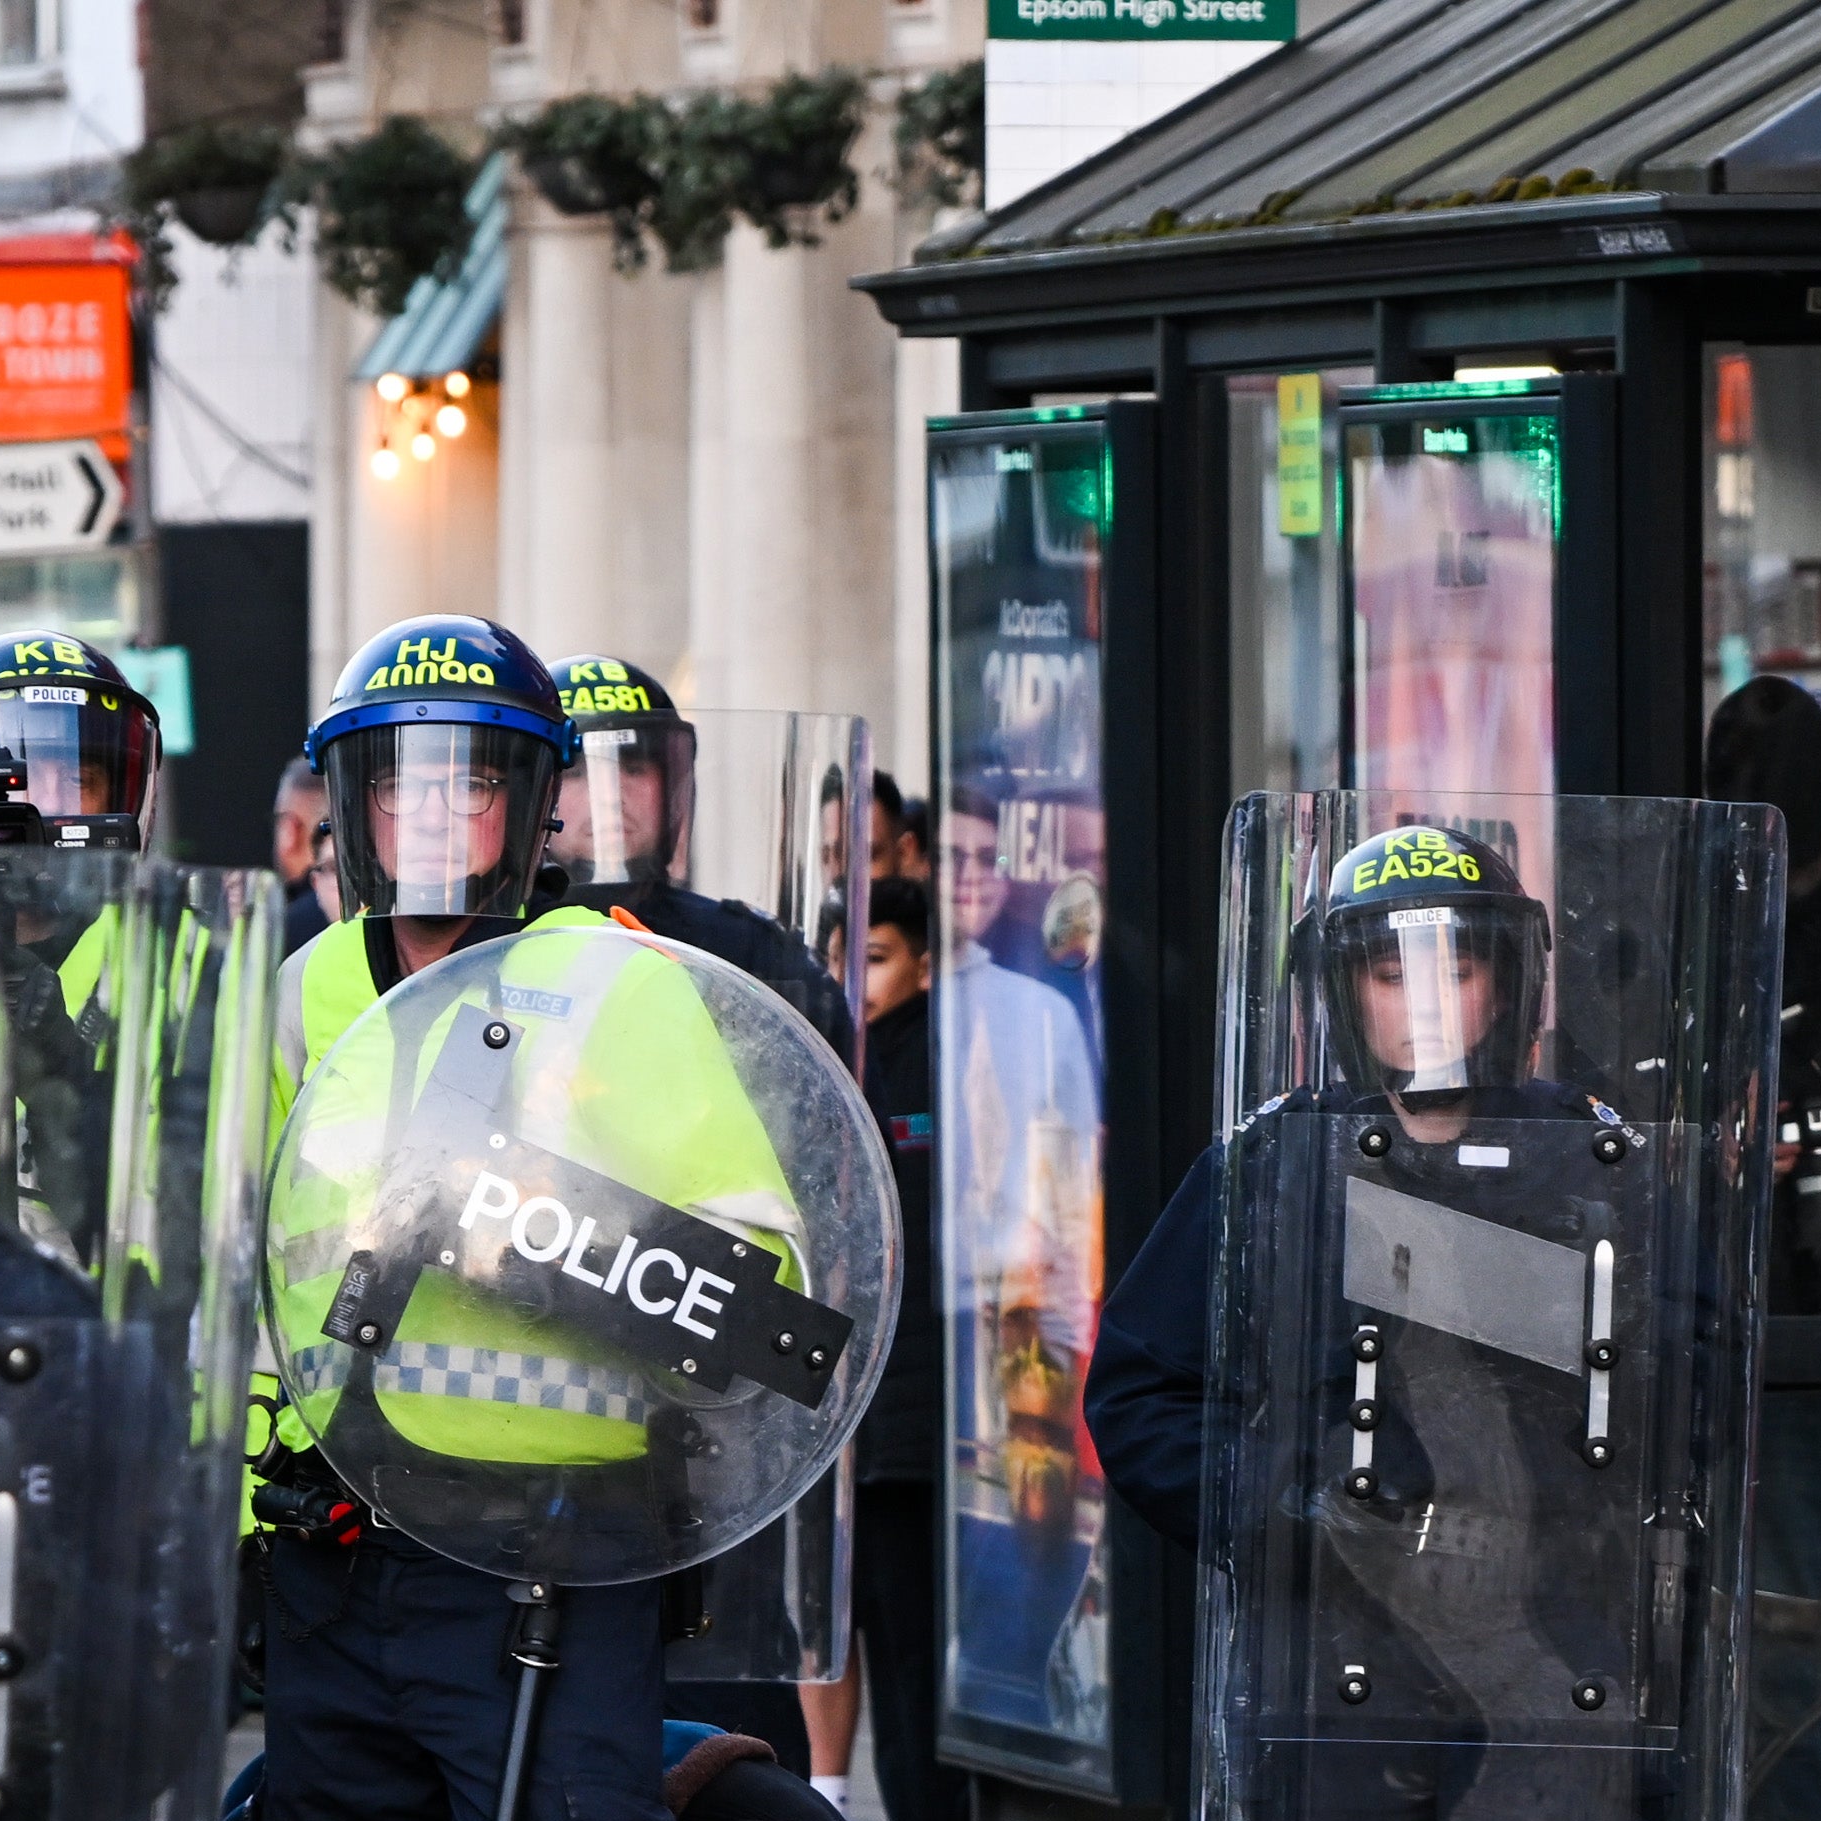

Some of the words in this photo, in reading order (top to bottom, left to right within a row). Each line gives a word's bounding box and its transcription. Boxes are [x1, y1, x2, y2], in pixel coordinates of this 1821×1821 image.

[1018, 0, 1106, 26] Epsom
[1114, 0, 1177, 28] High
[1183, 0, 1266, 22] Street
[4, 346, 105, 382] TOWN
[0, 464, 61, 492] Hall
[13, 640, 84, 665] KB
[396, 637, 457, 664] HJ
[569, 662, 629, 683] KB
[31, 687, 79, 702] POLICE
[53, 840, 86, 848] Canon
[1384, 832, 1448, 855] KB
[1353, 850, 1481, 894] EA526
[1396, 909, 1444, 925] POLICE
[458, 1170, 736, 1341] POLICE
